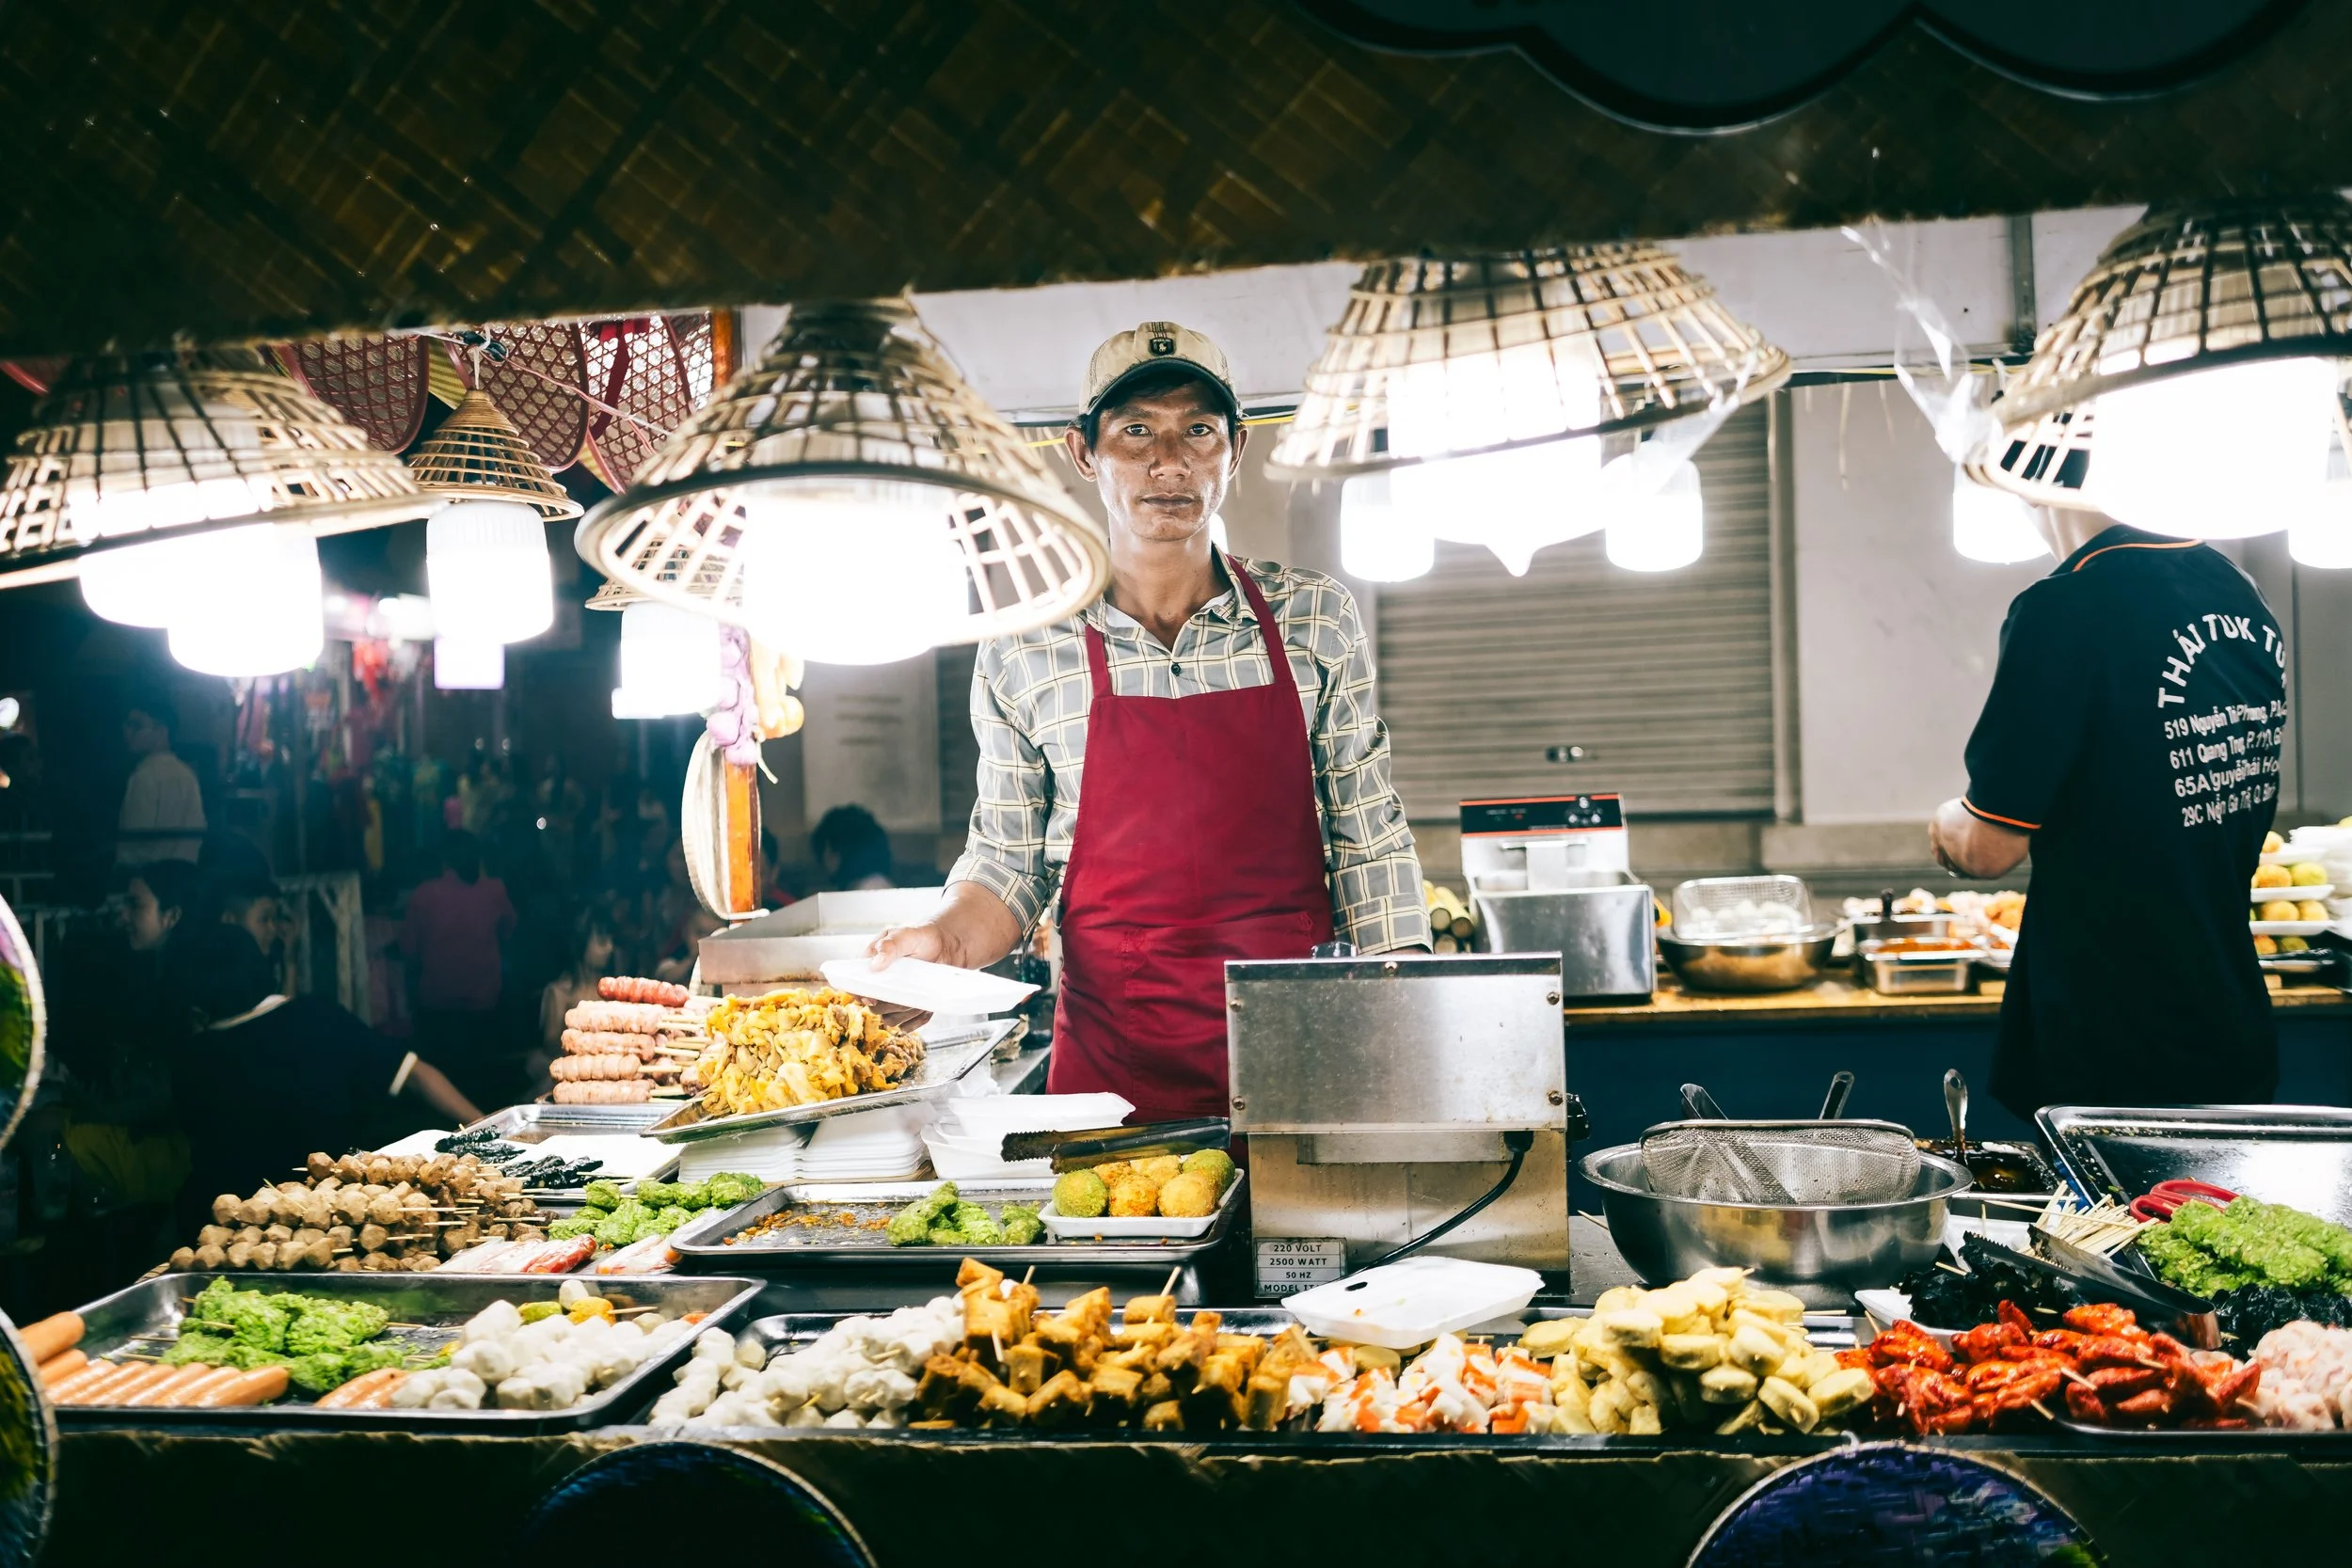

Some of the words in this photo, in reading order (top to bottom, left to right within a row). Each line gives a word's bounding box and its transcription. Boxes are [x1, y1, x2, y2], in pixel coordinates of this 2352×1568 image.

[2157, 623, 2206, 708] THÁI
[2201, 613, 2257, 642] TUK
[2164, 718, 2189, 739] 519
[2169, 746, 2194, 769] 611
[2174, 773, 2212, 798] 65A
[2182, 803, 2204, 828] 29C
[1274, 1244, 1293, 1253] 220
[1295, 1244, 1322, 1253] VOLT
[1269, 1258, 1295, 1266] 2500
[1297, 1258, 1327, 1266] WATT
[1285, 1271, 1296, 1279] 50
[1299, 1271, 1311, 1279] HZ
[1263, 1284, 1300, 1292] MODEL
